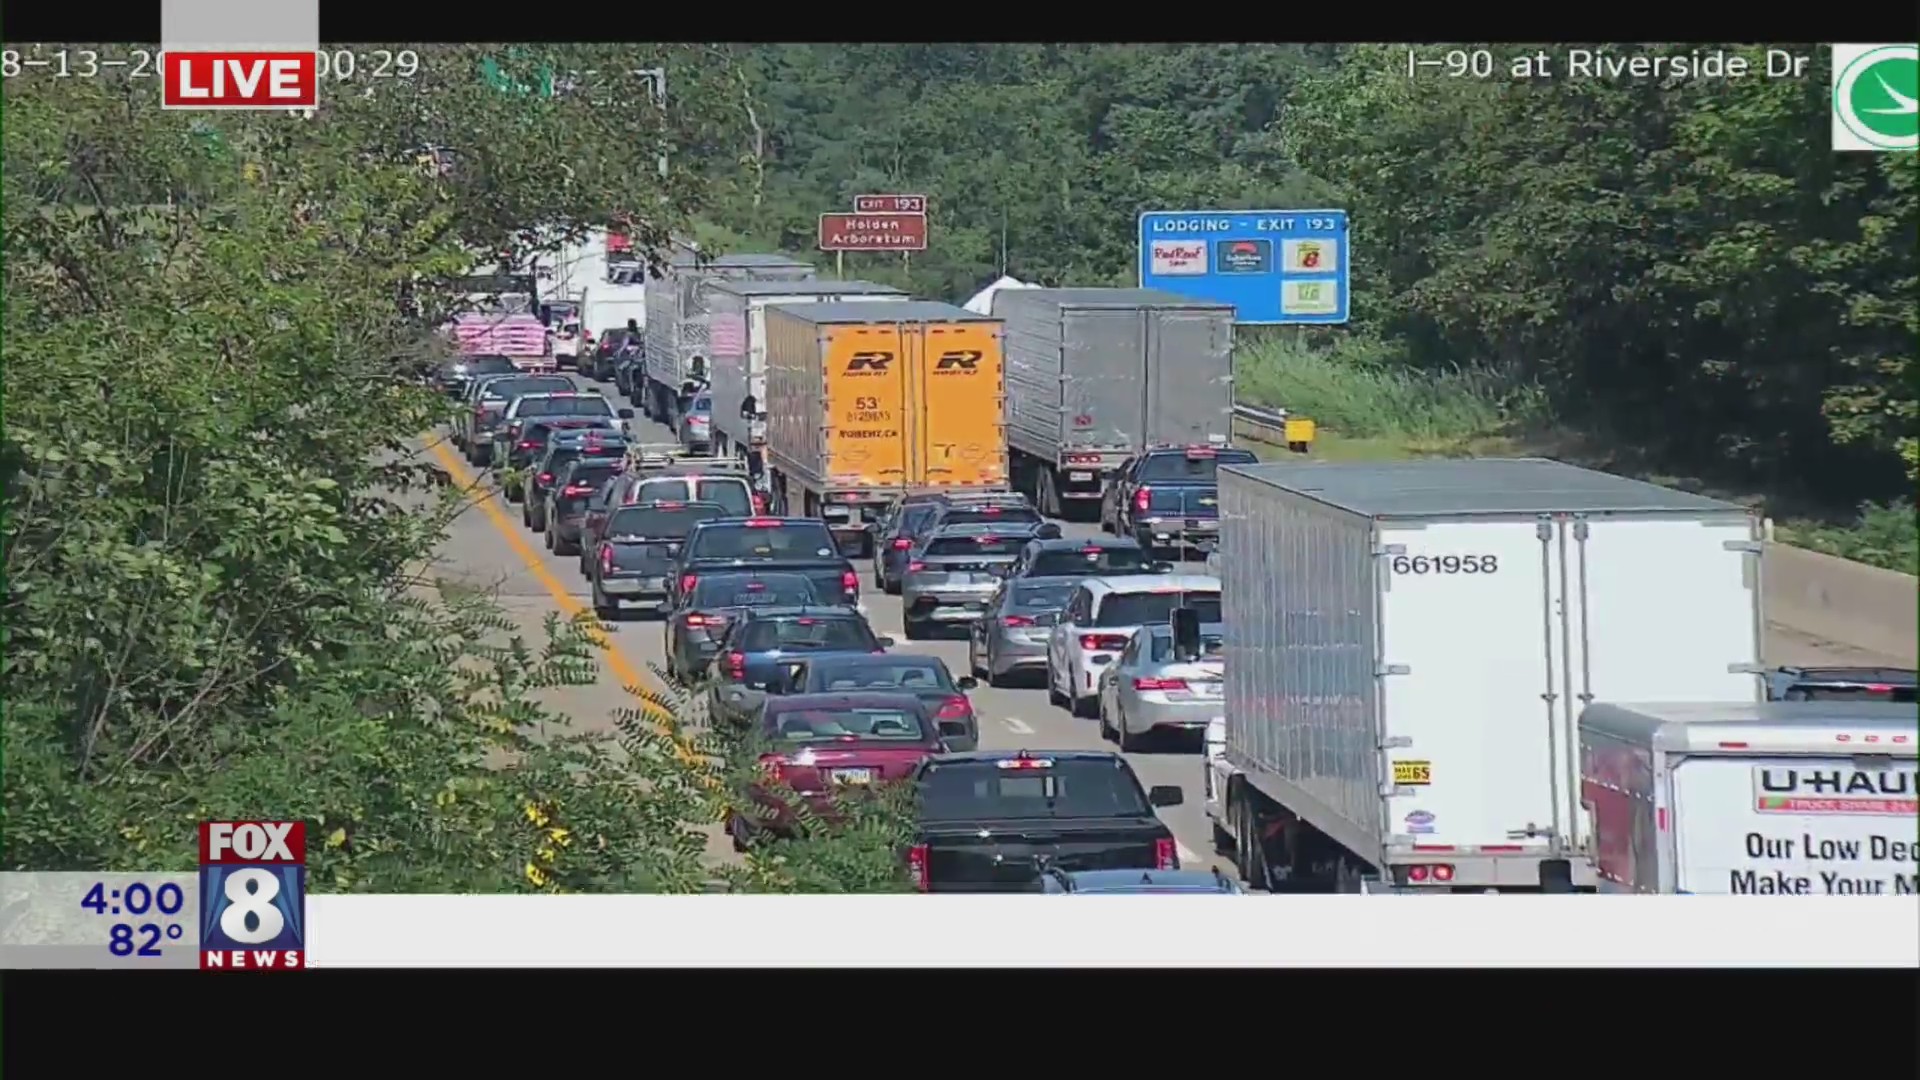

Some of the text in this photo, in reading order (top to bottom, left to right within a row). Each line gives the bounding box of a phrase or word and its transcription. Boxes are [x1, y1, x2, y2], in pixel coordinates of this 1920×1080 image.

[894, 198, 921, 210] 193
[845, 218, 899, 230] Holden
[1153, 219, 1230, 232] LODGING
[1257, 218, 1295, 231] EXIT
[1306, 218, 1335, 230] 193
[831, 233, 916, 244] Arboretum
[1393, 555, 1498, 575] 661958
[1412, 767, 1430, 780] 65
[1762, 770, 1919, 794] U-HAU
[1746, 832, 1794, 859] Our
[1804, 833, 1860, 860] Low
[1730, 869, 1811, 895] Make
[1820, 871, 1886, 895] Your
